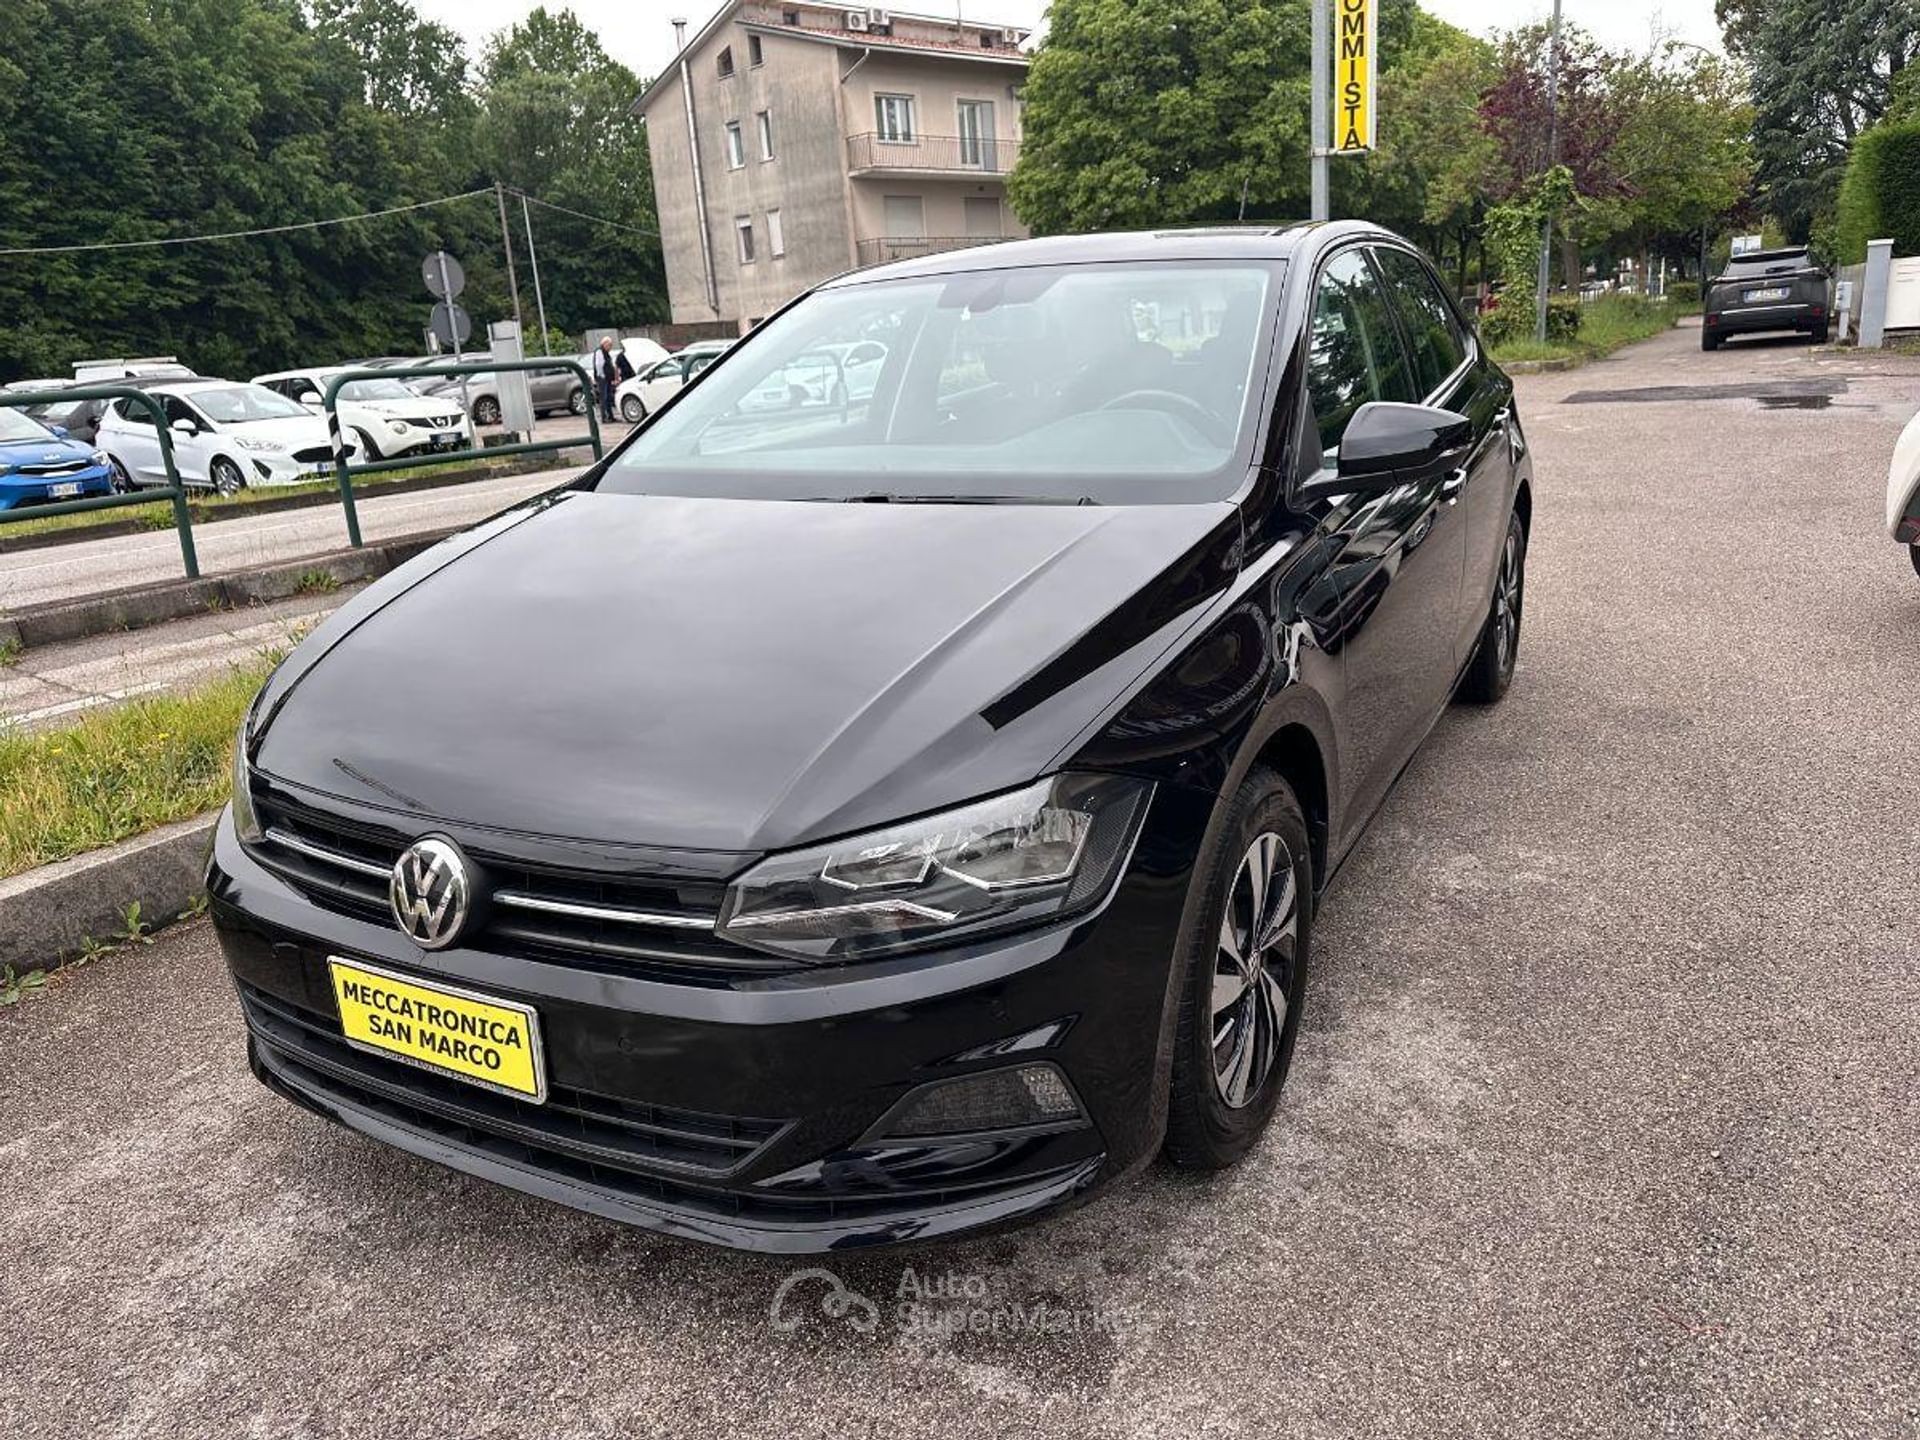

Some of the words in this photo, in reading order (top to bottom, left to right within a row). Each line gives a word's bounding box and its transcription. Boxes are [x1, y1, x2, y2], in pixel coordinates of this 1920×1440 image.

[343, 980, 521, 1048] MECCATRONICA
[368, 1014, 412, 1044] SAN
[419, 1029, 500, 1070] MARCO
